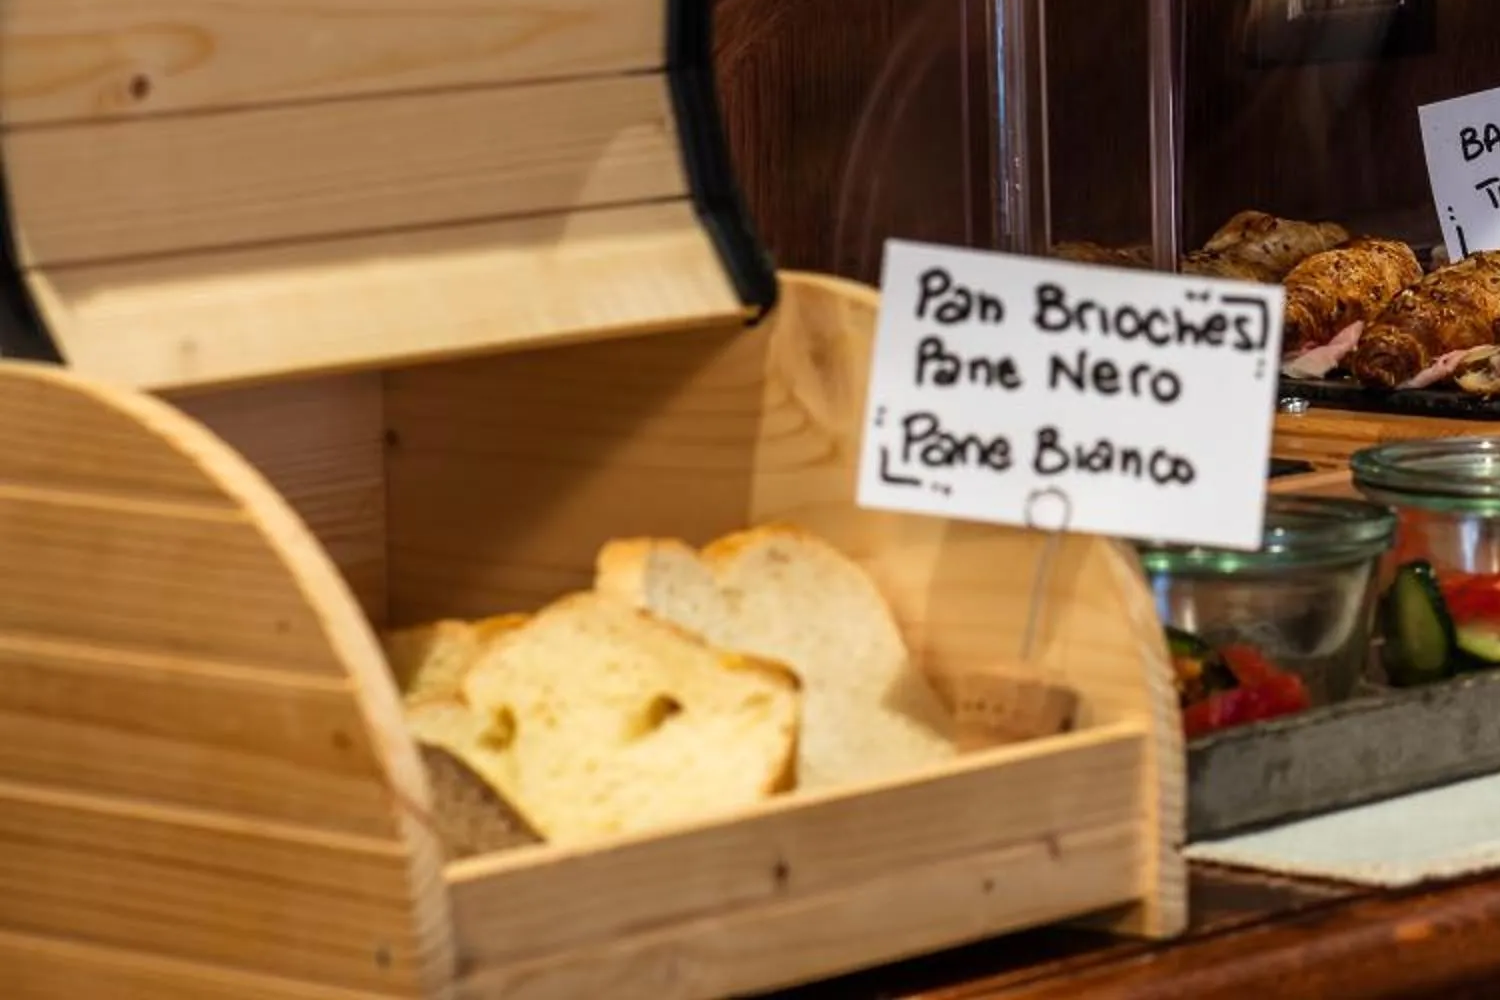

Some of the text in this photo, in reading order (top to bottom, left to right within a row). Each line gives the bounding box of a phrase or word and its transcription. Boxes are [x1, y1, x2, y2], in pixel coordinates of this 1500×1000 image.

[914, 266, 1257, 352] Pan Brioches
[914, 336, 1182, 404] Pane Nero
[901, 411, 1197, 486] Pane Bianco
